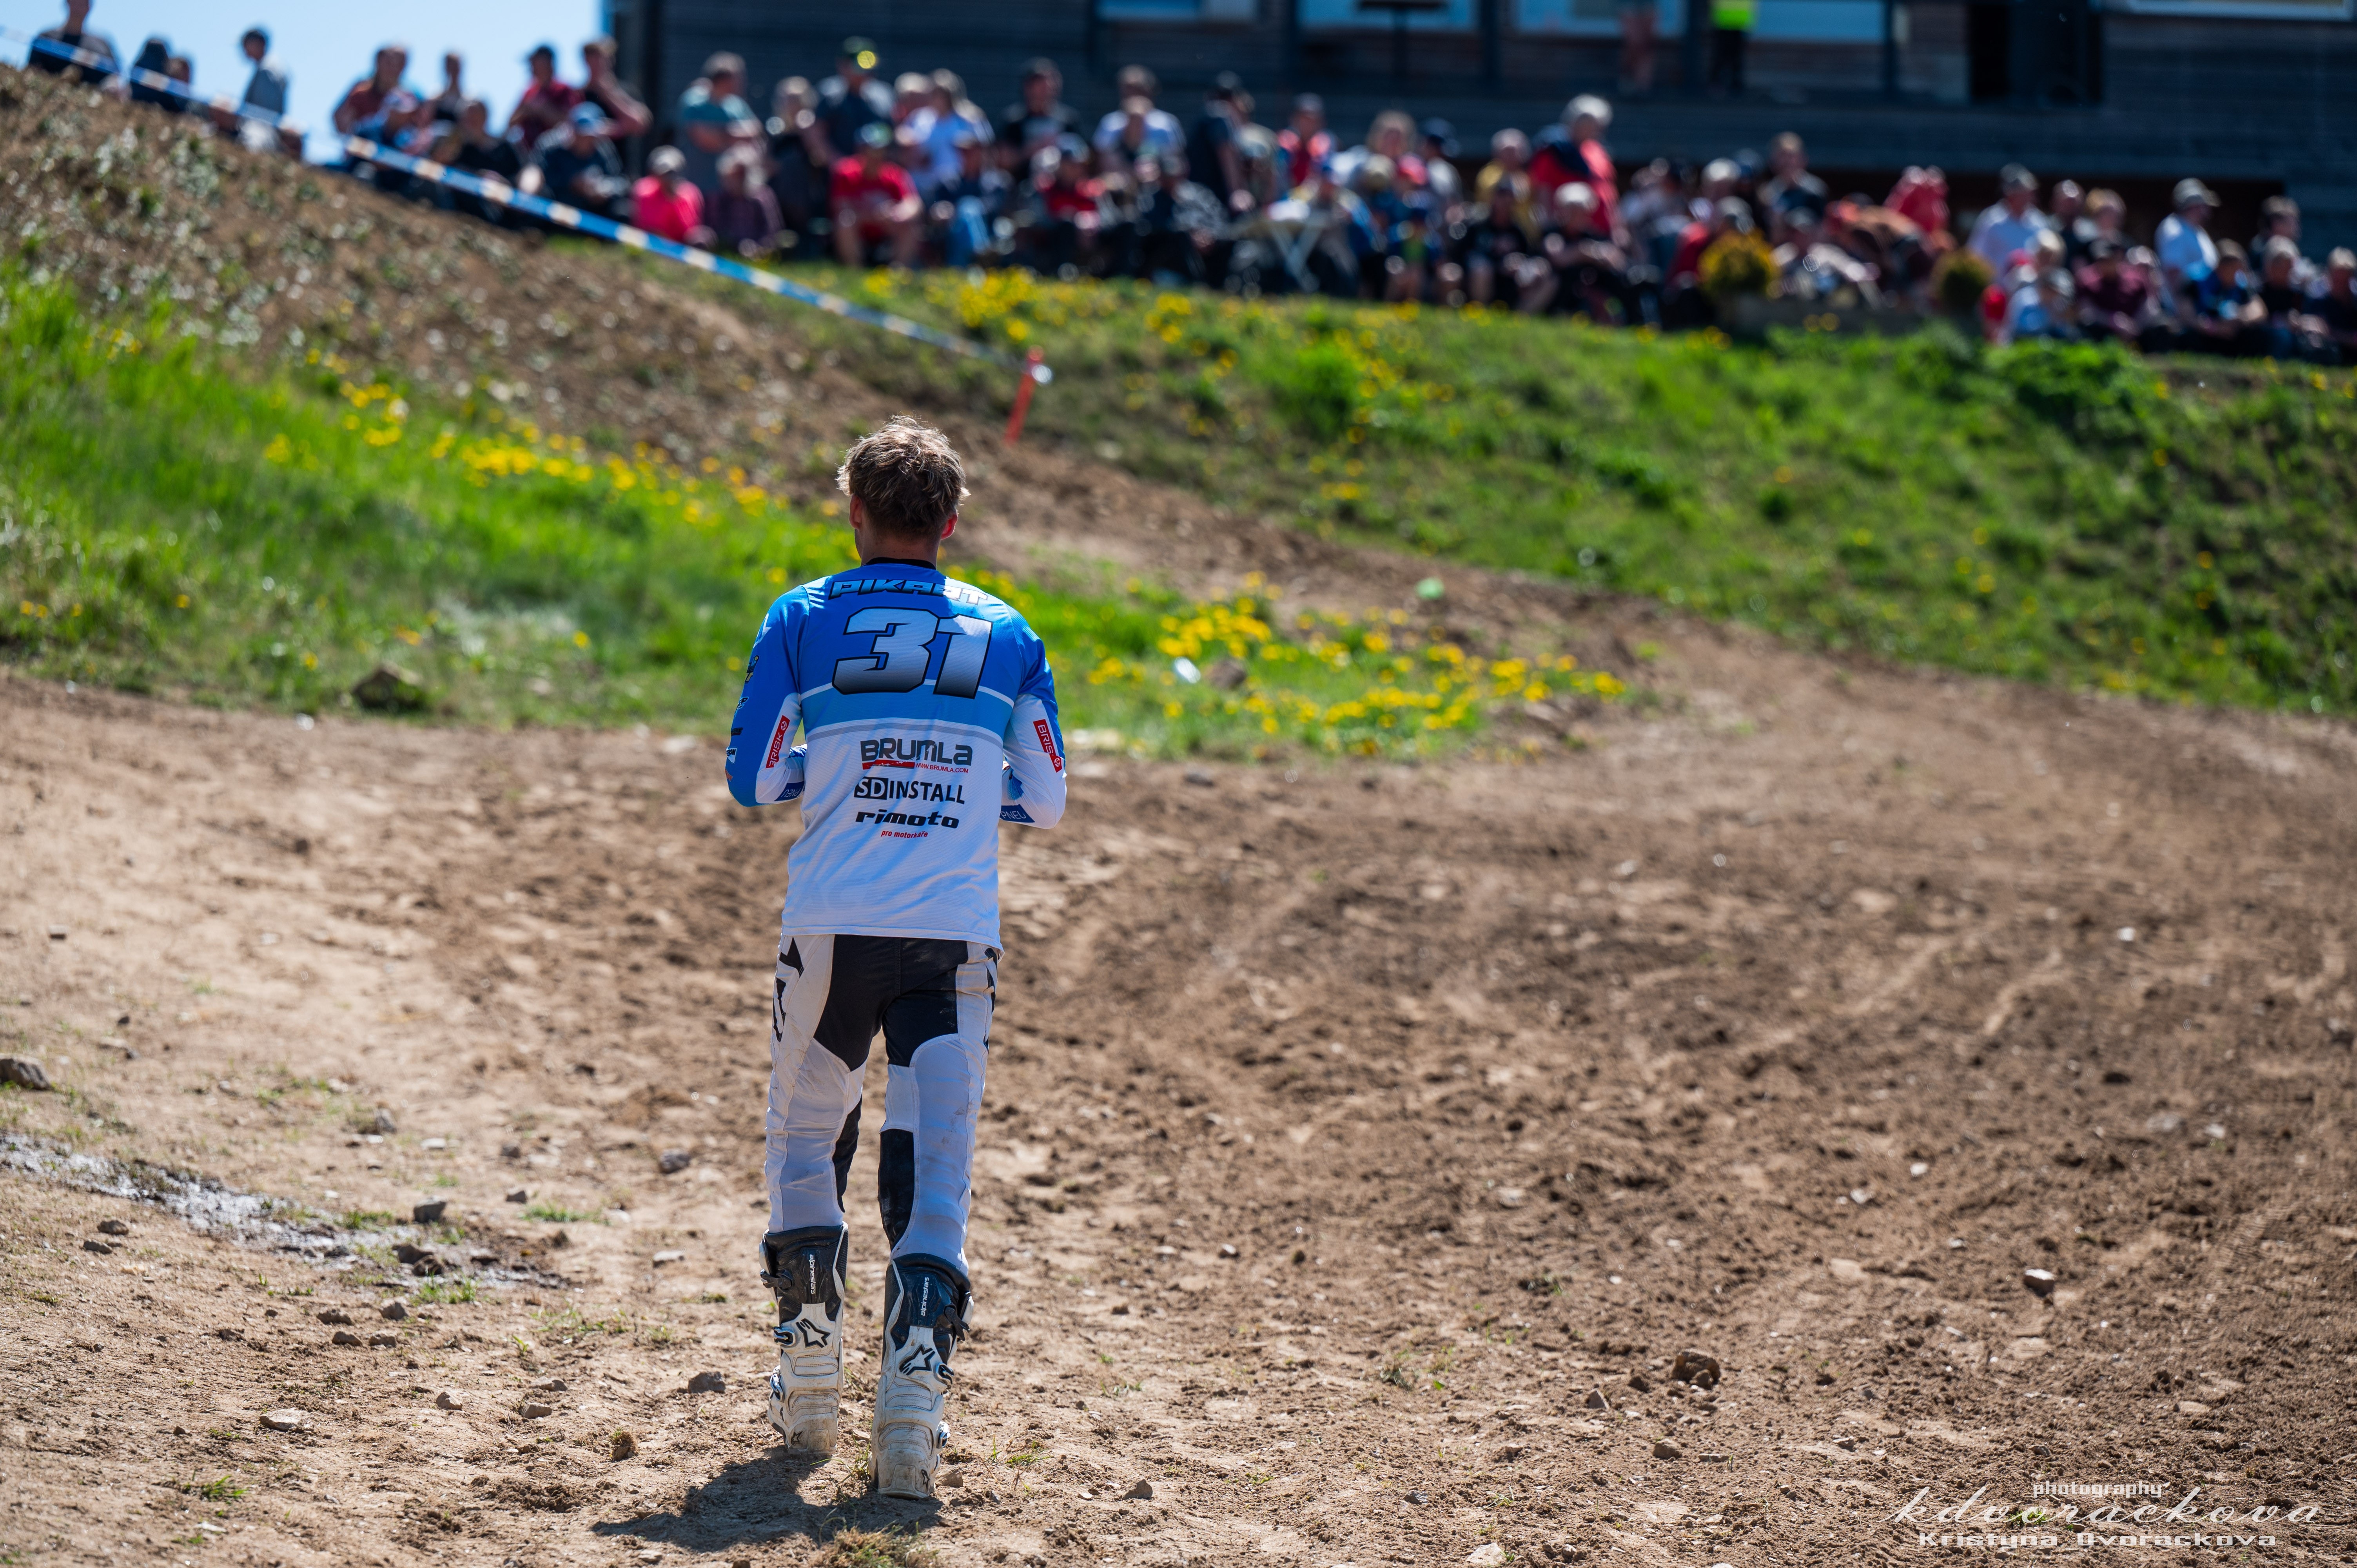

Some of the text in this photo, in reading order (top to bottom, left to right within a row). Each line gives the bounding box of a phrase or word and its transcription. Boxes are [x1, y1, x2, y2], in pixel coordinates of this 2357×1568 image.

[832, 606, 993, 700] 31
[1038, 724, 1054, 756] BRIS
[915, 763, 969, 774] WWW.BRUMLA.COM
[855, 809, 959, 829] rimoto
[808, 1254, 817, 1294] alpinestars
[920, 1277, 929, 1316] alpinestars
